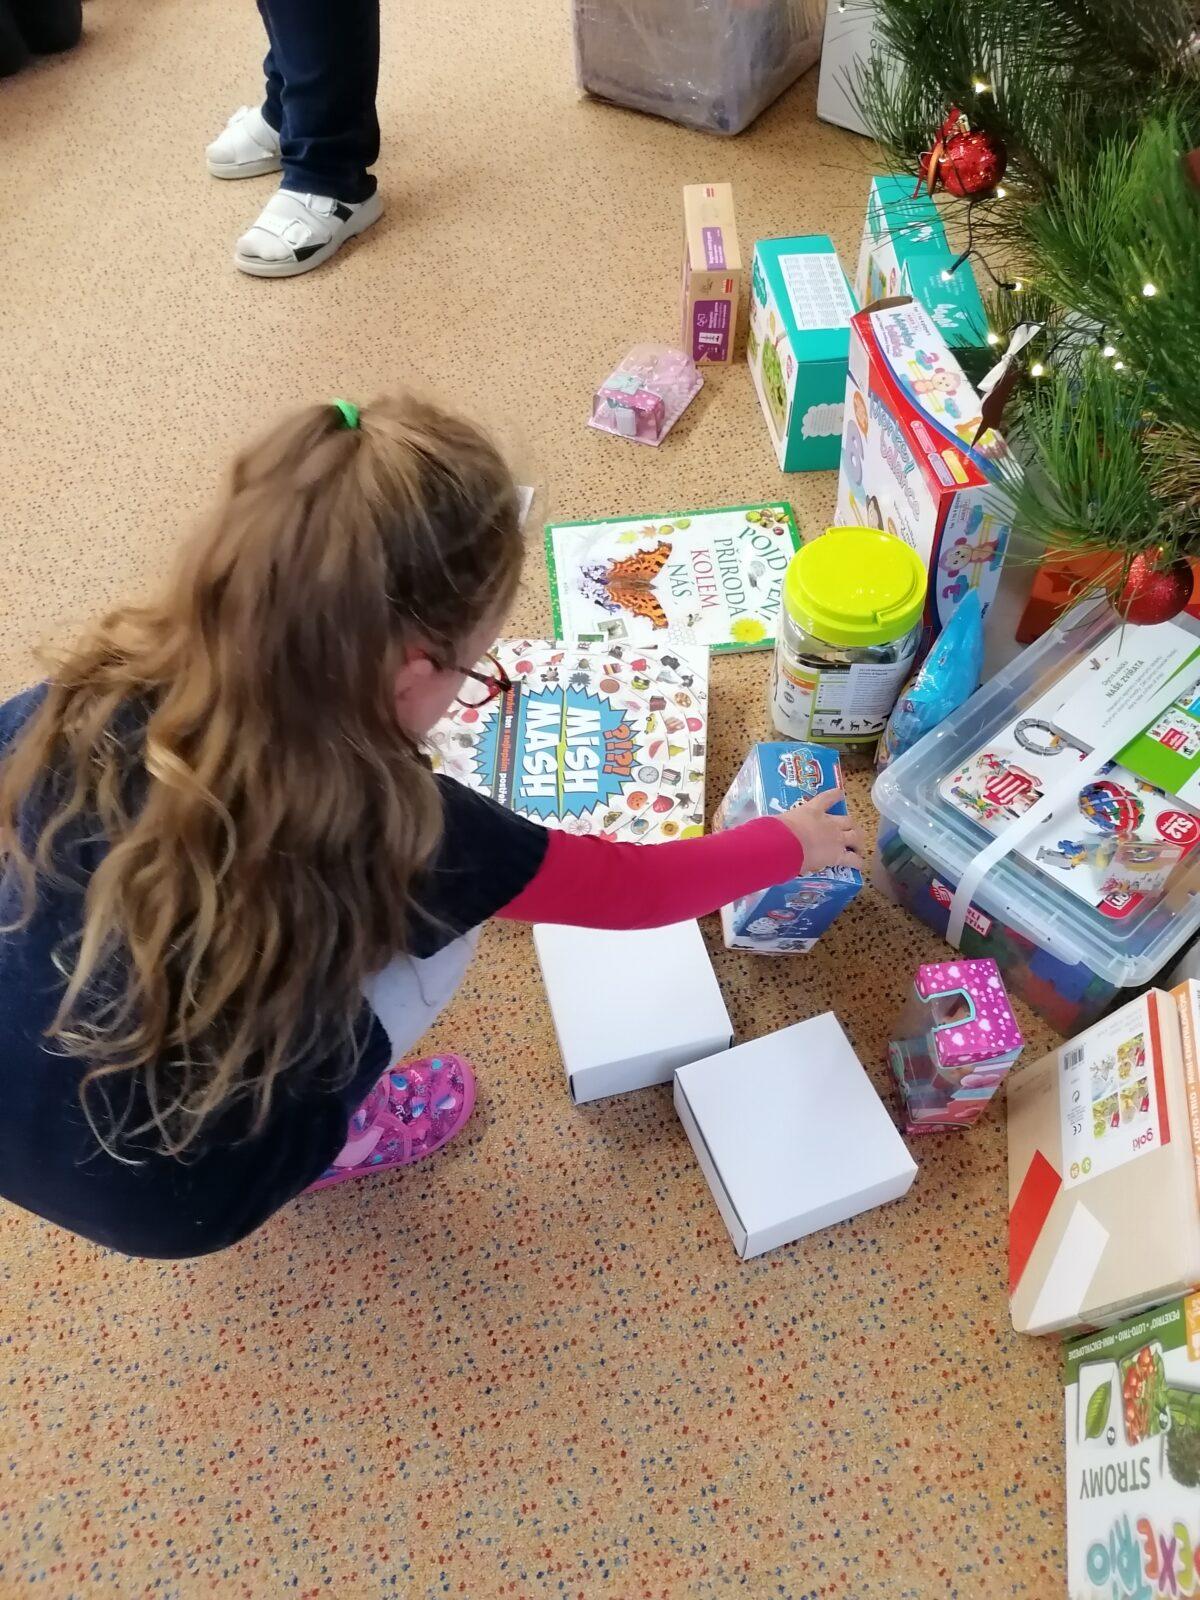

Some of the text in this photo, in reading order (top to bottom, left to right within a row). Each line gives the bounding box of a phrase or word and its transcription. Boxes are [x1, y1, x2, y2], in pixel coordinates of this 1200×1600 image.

[667, 562, 694, 598] NÁS
[690, 549, 721, 608] KOLEM
[713, 537, 749, 617] PŘÍRODA
[1105, 681, 1124, 698] NAŠE
[1120, 660, 1145, 683] ZVÍŘATA
[504, 715, 514, 729] ten
[498, 772, 510, 805] postřeh
[1164, 816, 1195, 840] 512
[1132, 1127, 1154, 1152] goki
[1118, 1322, 1147, 1342] LOTO-TRIO
[1079, 1456, 1151, 1500] STROMY
